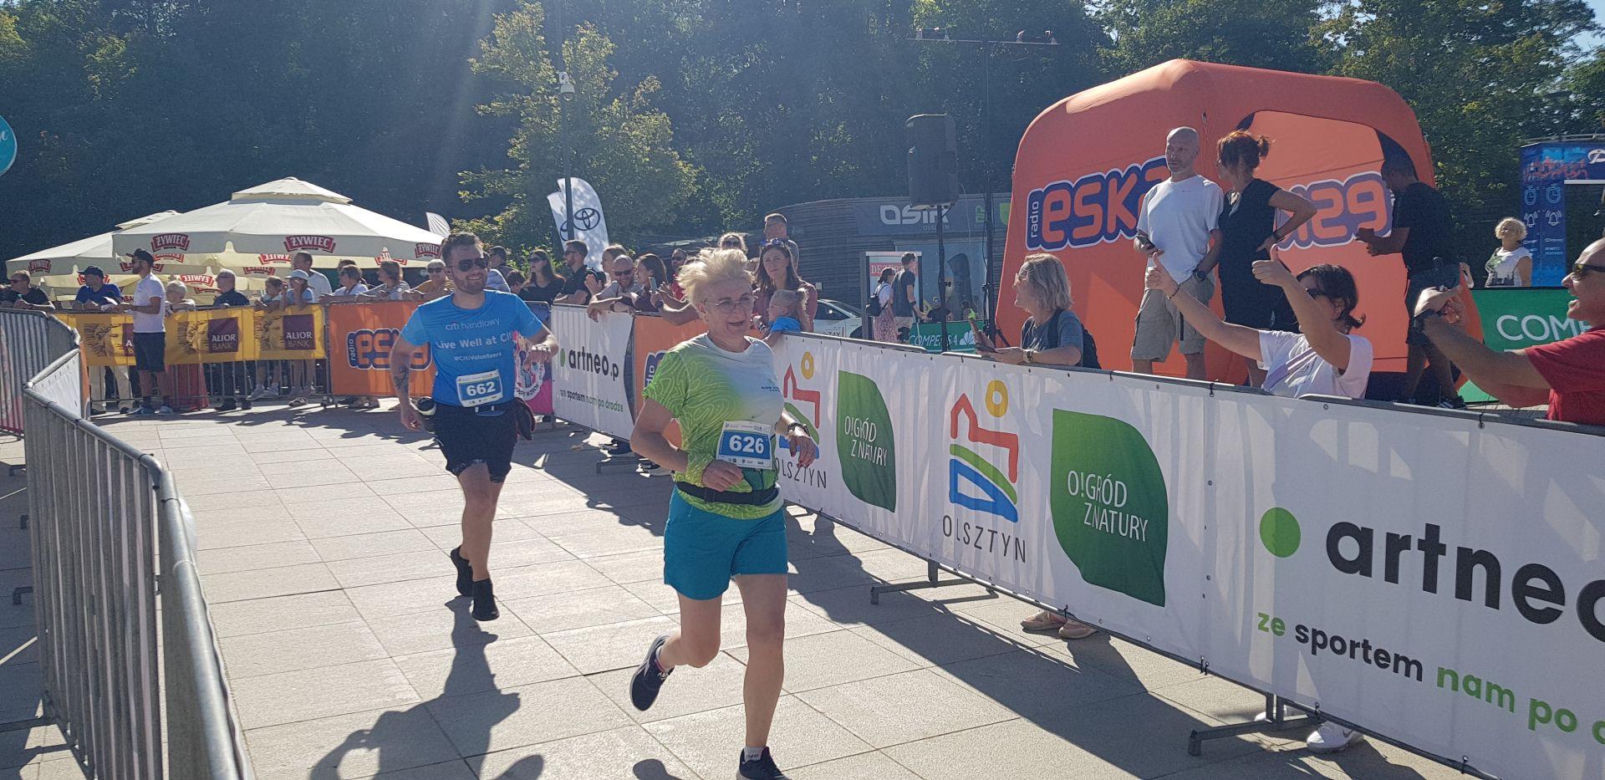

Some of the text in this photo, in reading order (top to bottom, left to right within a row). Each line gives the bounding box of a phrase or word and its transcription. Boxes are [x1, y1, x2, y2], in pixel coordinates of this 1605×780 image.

[1029, 200, 1040, 238] radio
[212, 334, 236, 342] ALIOR
[286, 332, 313, 340] ALIOR
[460, 338, 482, 348] Well
[486, 336, 497, 346] at
[910, 334, 958, 347] COMPESA
[466, 381, 496, 396] 662
[729, 435, 764, 454] 626
[1067, 470, 1128, 508] O!GRÓD
[942, 514, 1026, 564] OLSZTYN
[1257, 612, 1286, 637] ze
[1295, 624, 1423, 682] sportem
[1436, 666, 1516, 713] nam
[1528, 698, 1578, 732] po
